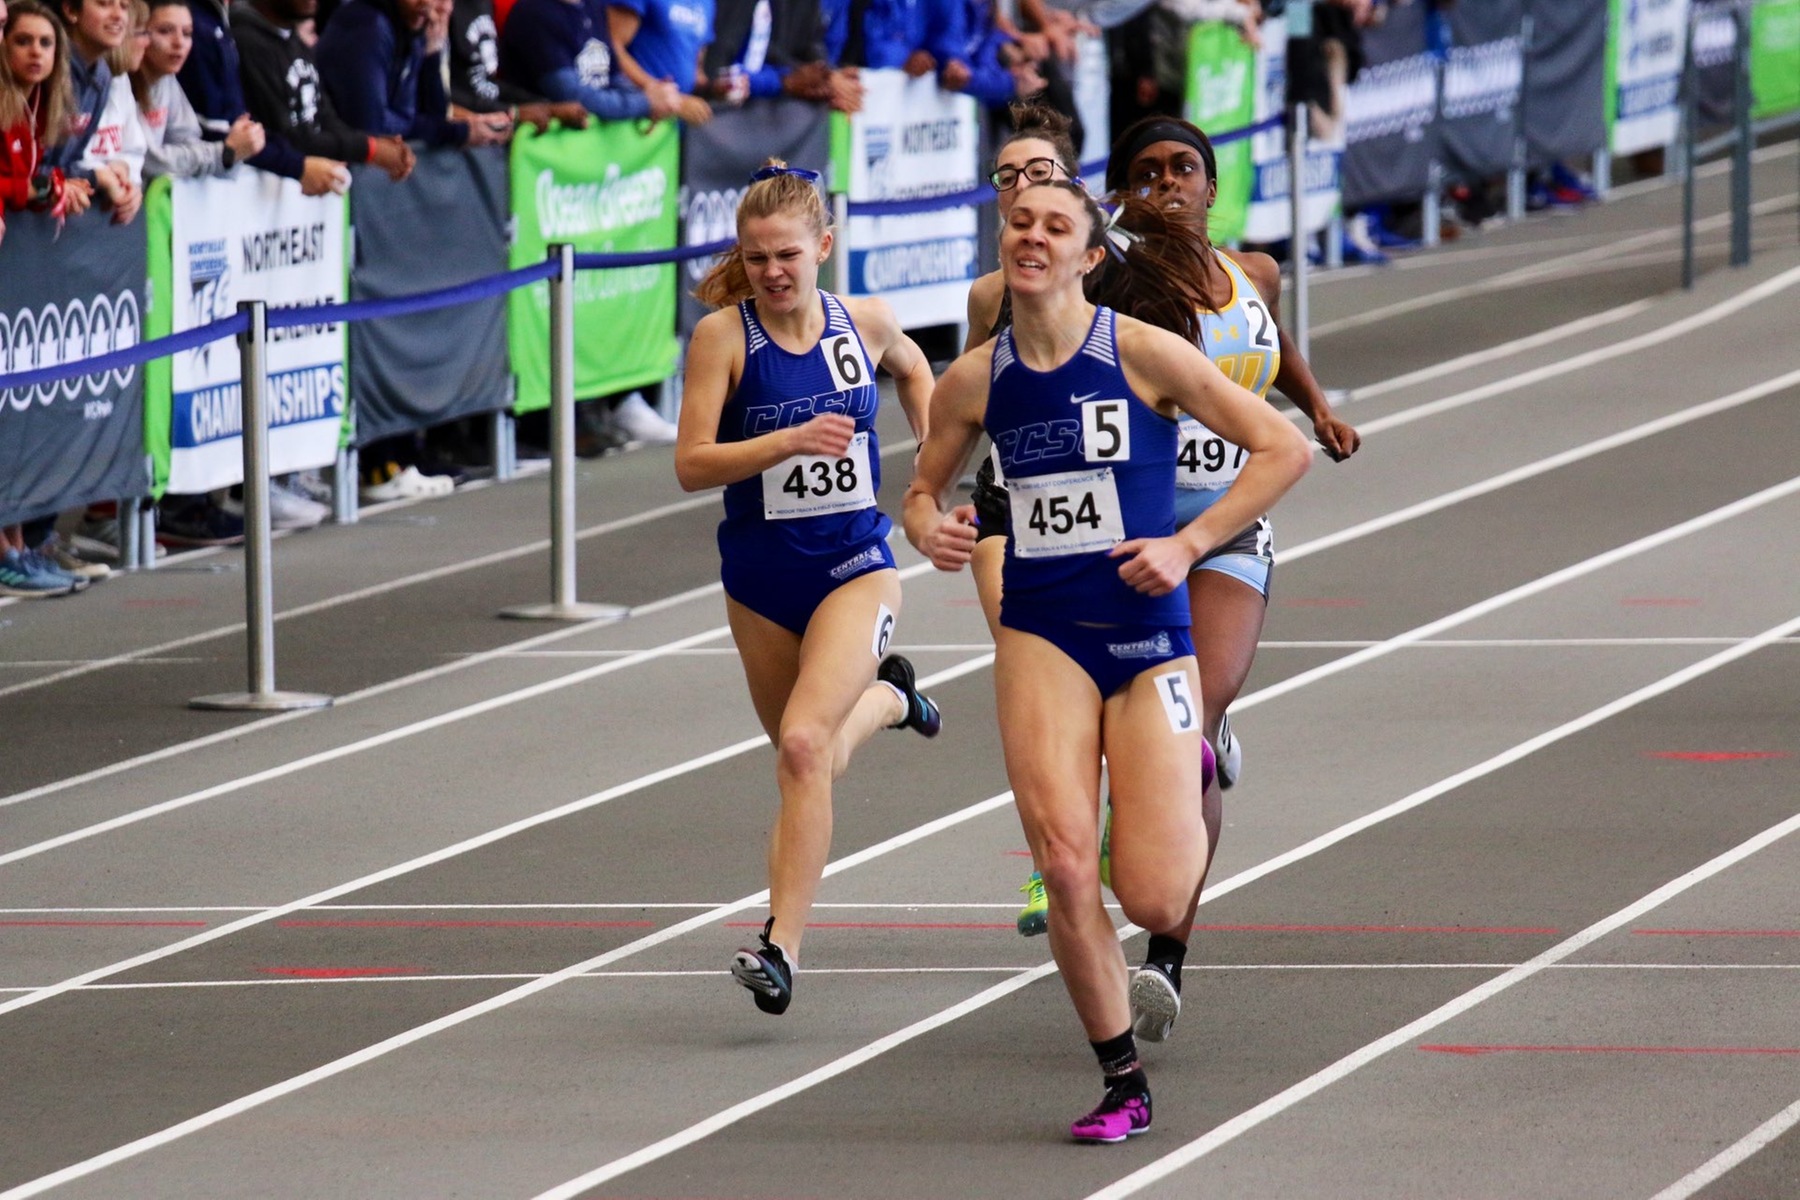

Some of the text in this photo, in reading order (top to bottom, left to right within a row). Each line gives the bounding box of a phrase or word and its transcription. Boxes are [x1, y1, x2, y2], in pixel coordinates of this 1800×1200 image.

[242, 222, 325, 274] NORTHEAST
[1247, 300, 1272, 347] 2
[833, 336, 861, 385] 6
[191, 364, 345, 444] CHAMNSHIPS
[996, 419, 1084, 470] CCS
[1095, 404, 1121, 458] 5
[783, 457, 857, 498] 438
[1029, 491, 1101, 536] 454
[831, 550, 869, 576] CENTRAL
[878, 614, 893, 659] 6
[1110, 640, 1155, 651] CENTRAL
[1167, 676, 1191, 729] 5
